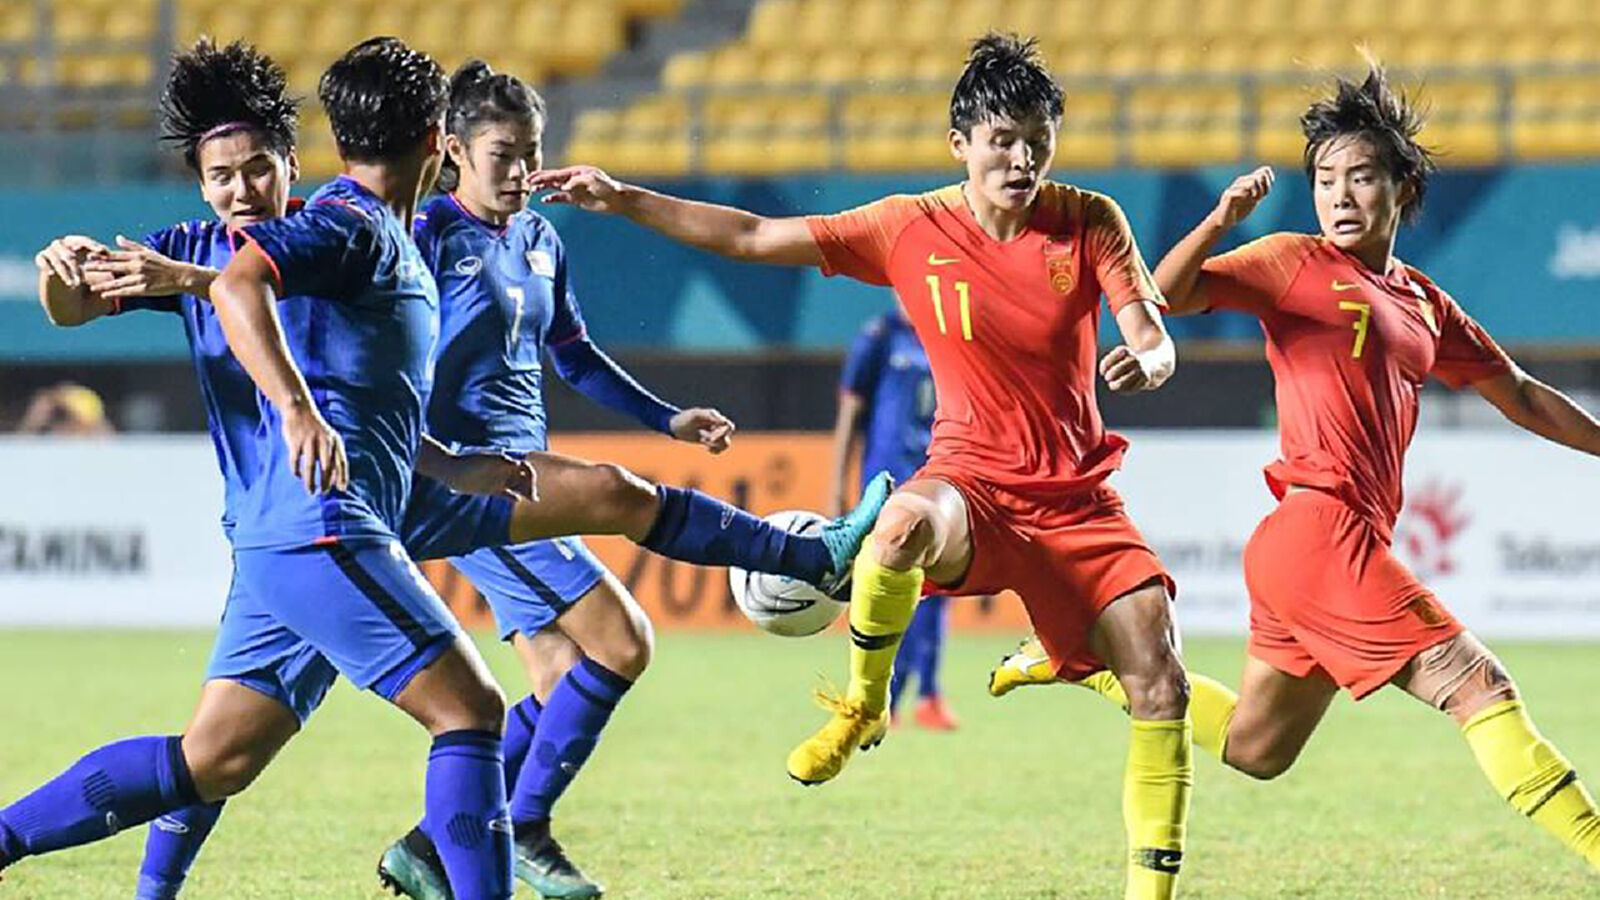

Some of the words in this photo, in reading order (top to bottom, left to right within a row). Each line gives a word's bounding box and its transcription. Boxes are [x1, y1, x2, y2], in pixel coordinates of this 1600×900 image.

[506, 286, 525, 344] 7
[926, 274, 973, 341] 11
[1338, 300, 1370, 358] 7
